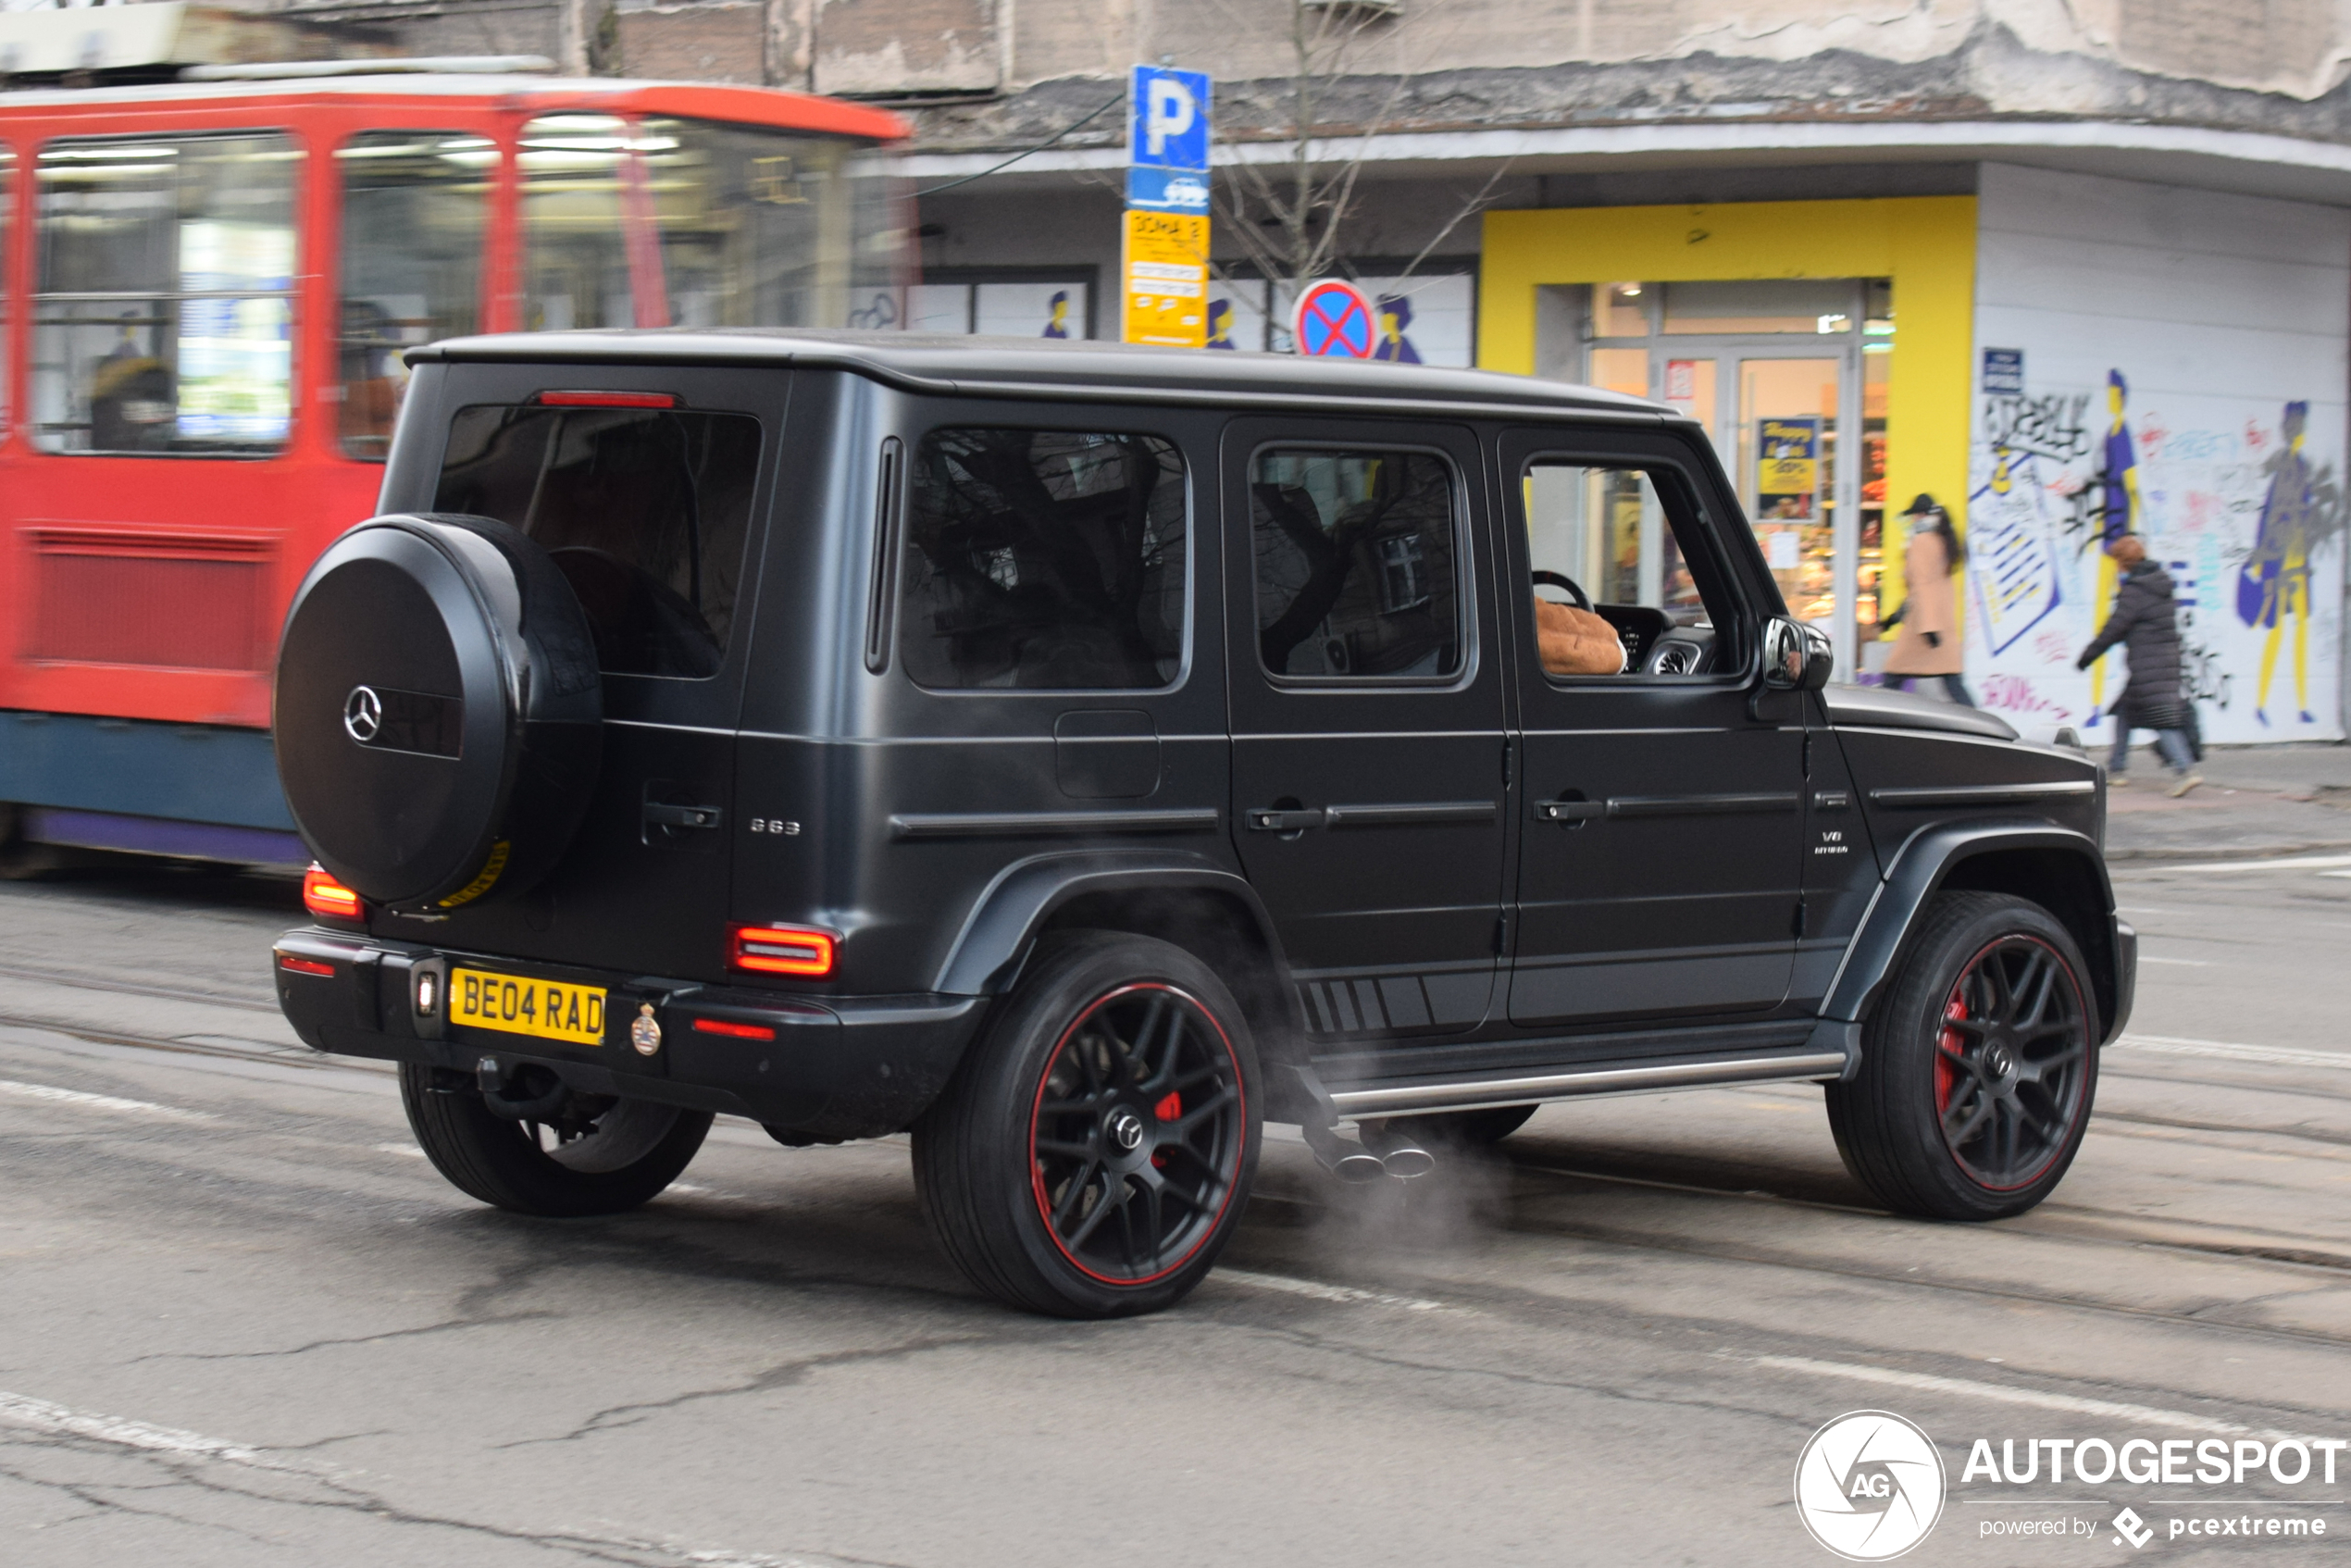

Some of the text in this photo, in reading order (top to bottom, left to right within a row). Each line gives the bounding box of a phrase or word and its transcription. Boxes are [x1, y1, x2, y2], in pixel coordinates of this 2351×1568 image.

[1146, 78, 1195, 156] P
[1822, 830, 1842, 842] V8
[463, 975, 603, 1034] BE04 RAD
